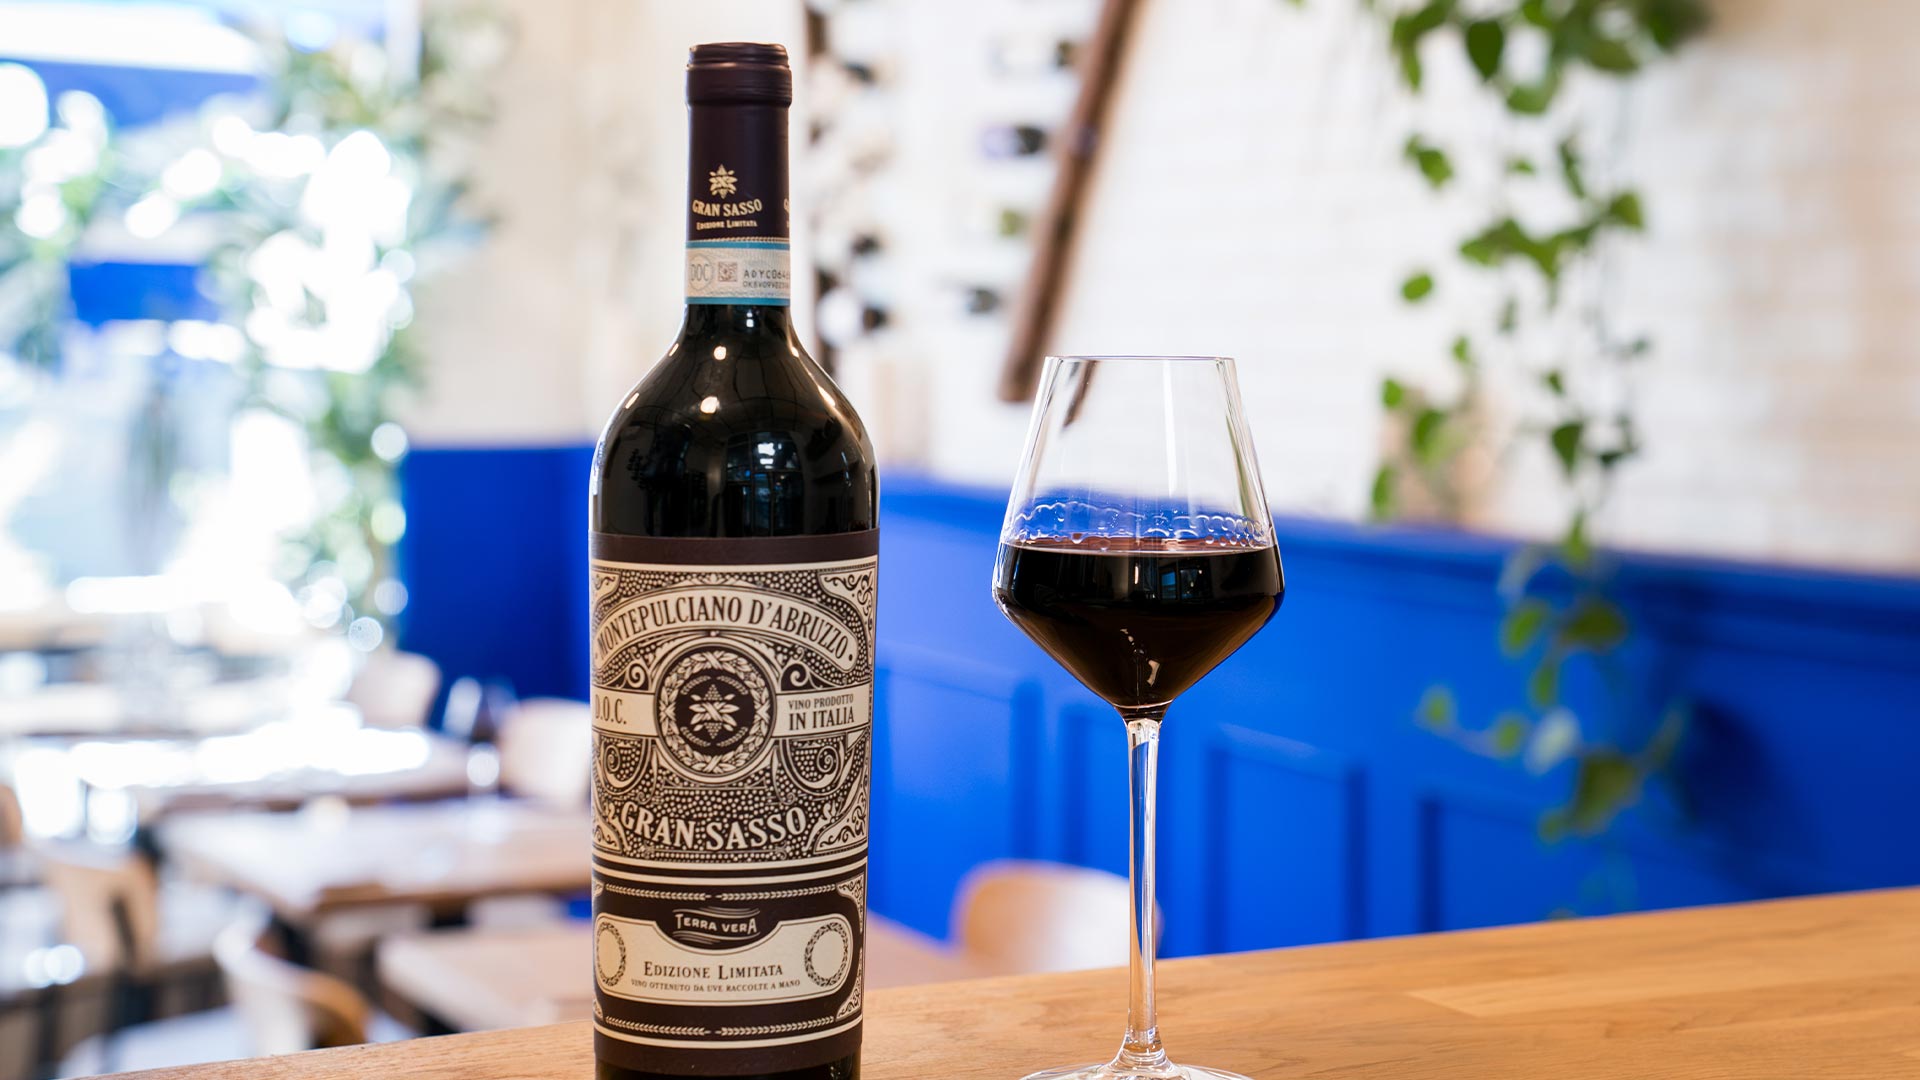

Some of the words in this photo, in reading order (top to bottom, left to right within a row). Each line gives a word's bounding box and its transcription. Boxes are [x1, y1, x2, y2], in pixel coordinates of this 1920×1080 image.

[692, 200, 720, 217] GRAN
[723, 198, 763, 217] SASSO
[696, 221, 725, 230] EDIZIONE
[726, 220, 758, 229] LIMITATA
[690, 263, 711, 282] DOC
[597, 596, 742, 661] MONTEPULCIANO
[748, 598, 850, 661] D'ABRUZZO
[595, 694, 627, 725] D.O.C.
[788, 699, 811, 710] VINO
[814, 693, 854, 708] PRODOTTO
[789, 712, 806, 731] IN
[812, 706, 854, 729] ITALIA
[621, 801, 696, 850] GRAN
[706, 806, 808, 851] SASSO
[675, 913, 718, 932] TERRA
[643, 961, 711, 979] EDIZIONE
[718, 964, 783, 980] LIMITATA
[631, 979, 648, 988] VINO
[650, 982, 691, 992] OTTENUTO
[707, 985, 723, 993] UVE
[726, 983, 769, 993] RACCOLTE
[779, 979, 801, 989] MANO
